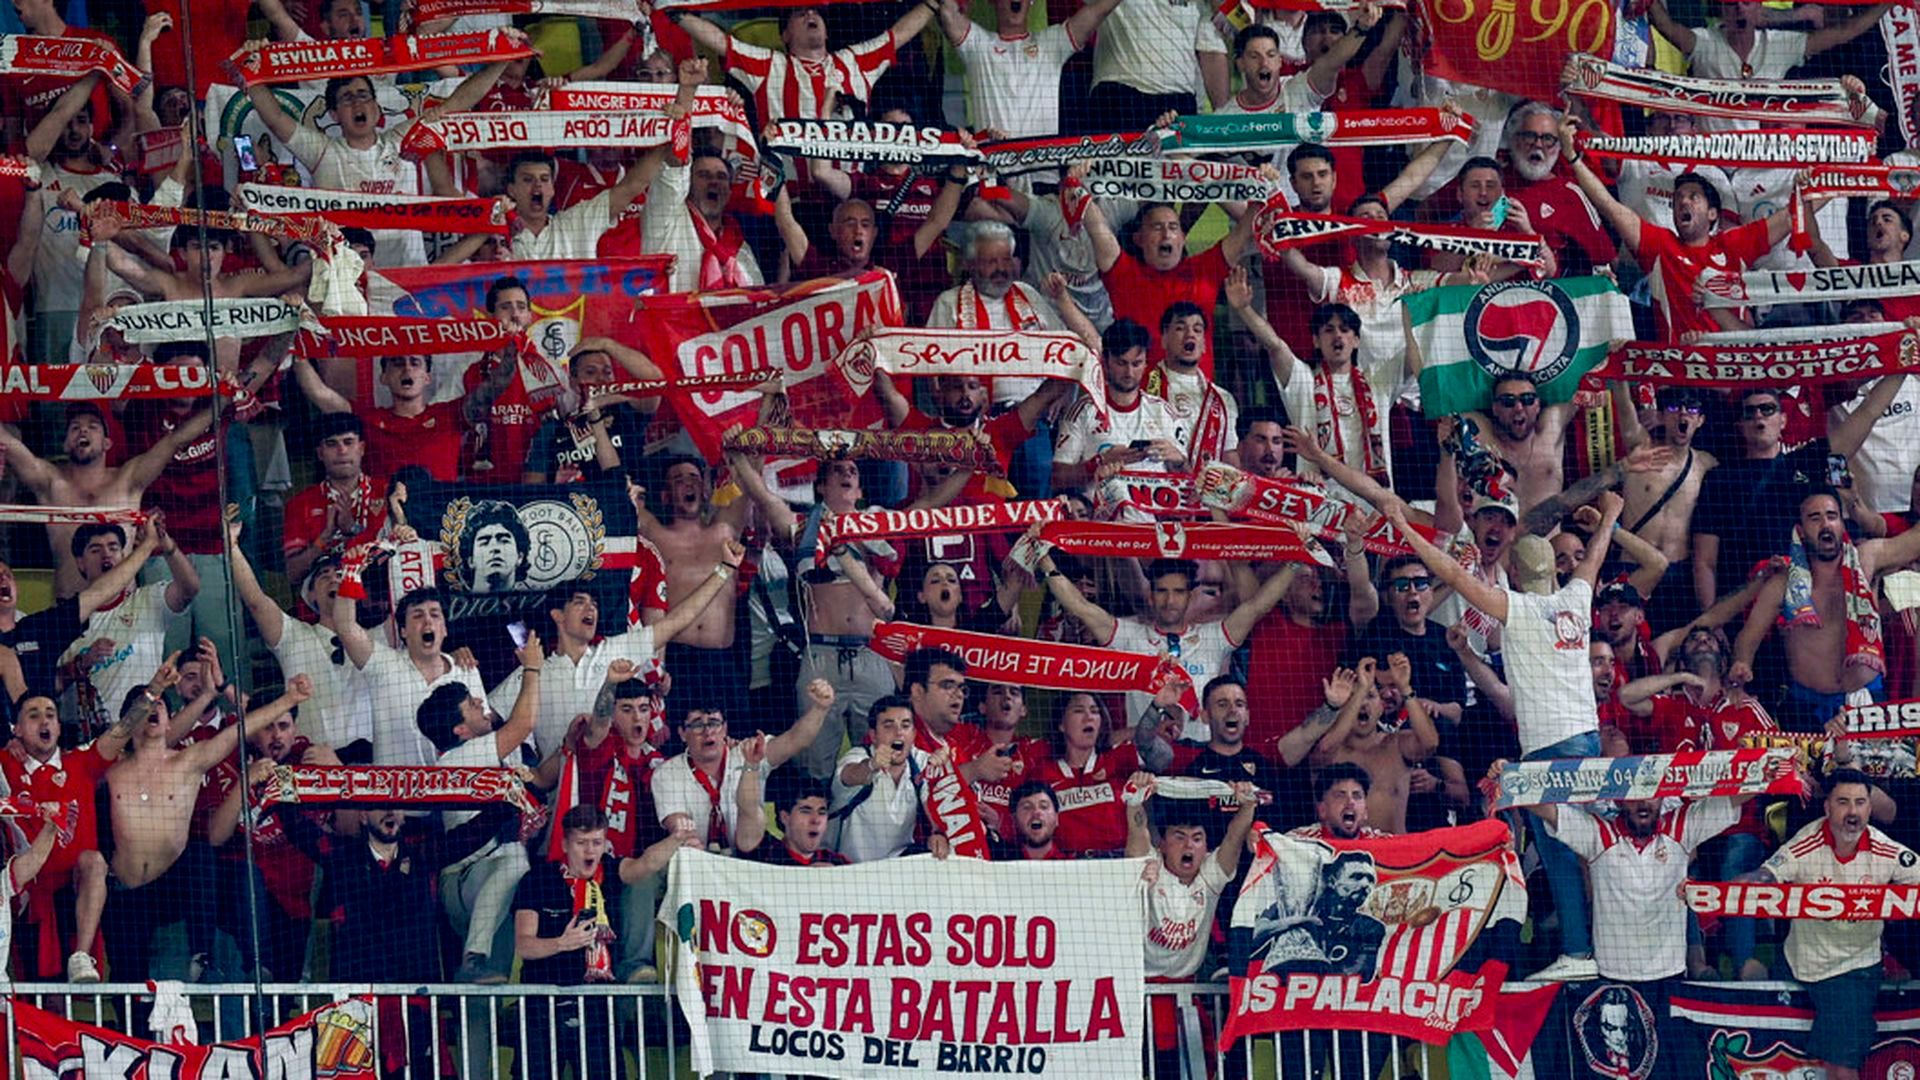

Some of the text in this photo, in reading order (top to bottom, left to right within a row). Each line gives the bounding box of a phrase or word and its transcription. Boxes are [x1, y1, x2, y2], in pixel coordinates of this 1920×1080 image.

[32, 41, 83, 58] evilla
[269, 45, 373, 67] SEVILLA F.C.
[567, 92, 626, 111] SANGRE
[780, 121, 942, 149] PARADAS
[1796, 134, 1868, 163] SEVILLA
[878, 148, 923, 163] FANS
[1087, 159, 1153, 179] NADIE
[1162, 160, 1183, 180] LA
[1802, 170, 1880, 189] villista
[243, 188, 300, 210] Dicen
[304, 197, 342, 214] que
[347, 200, 407, 216] nunca
[1090, 180, 1267, 200] COMO NOSOTROS
[1815, 263, 1920, 292] SEVILLA
[393, 266, 572, 319] SEVILA
[115, 303, 301, 331] NUNCA TE RINDA
[400, 323, 430, 343] TE
[898, 340, 1028, 369] Sevilla
[1715, 342, 1880, 364] SEVILLISTA
[1622, 354, 1884, 381] LA REBOTICA
[1881, 400, 1912, 418] dea
[888, 504, 997, 533] DONDE
[1004, 501, 1060, 523] VAY
[1531, 768, 1608, 790] SCHALKE
[1613, 768, 1633, 784] 04
[1664, 763, 1733, 785] SEVILLA
[1094, 787, 1112, 800] FC
[1685, 884, 1846, 918] BIRIS
[699, 898, 1057, 970] NO ESTAS SOLO
[700, 964, 1125, 1045] EN ESTA BATALLA
[748, 1024, 1046, 1075] LOCOS DEL BARRIO
